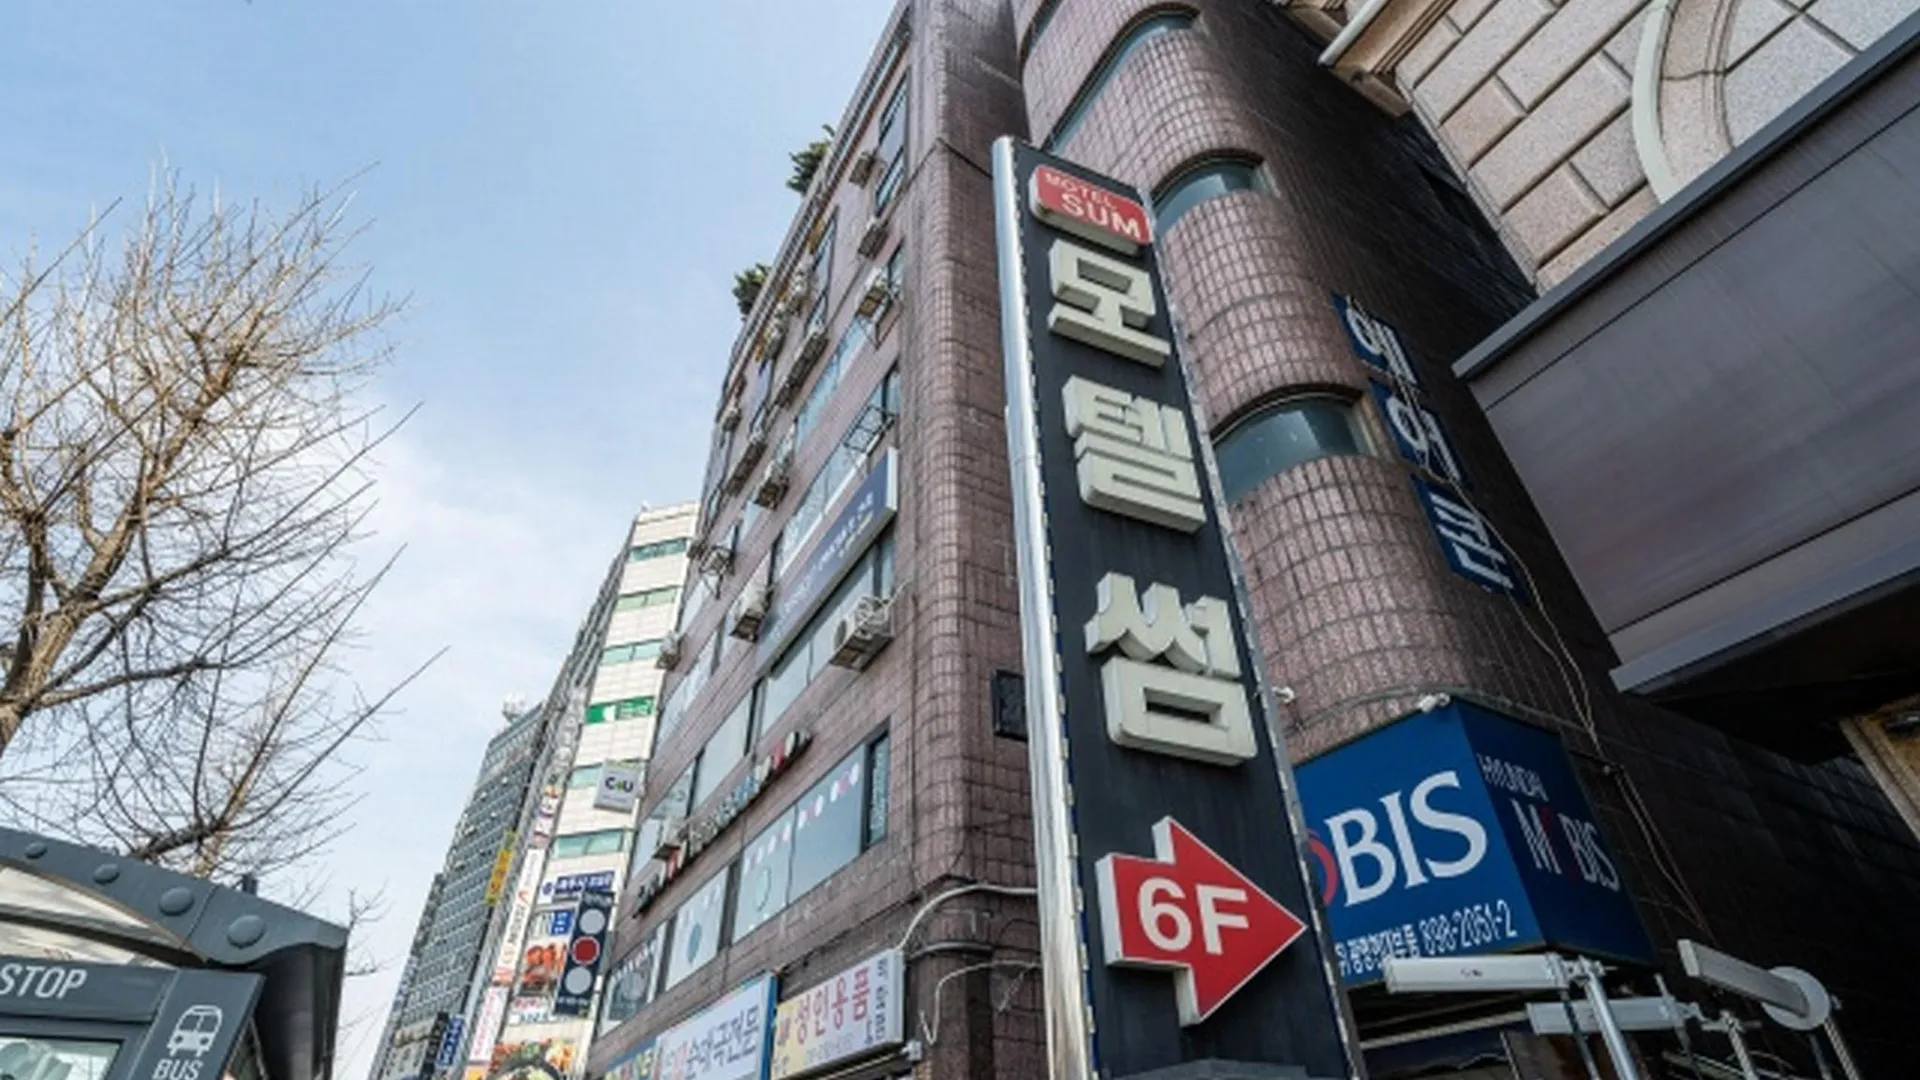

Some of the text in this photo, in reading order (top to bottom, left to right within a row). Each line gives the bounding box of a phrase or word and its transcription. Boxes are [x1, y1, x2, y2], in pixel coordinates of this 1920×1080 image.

[1044, 172, 1118, 211] MOTEL
[1060, 193, 1141, 239] SUM
[1137, 876, 1250, 956] 6F
[0, 963, 88, 1000] STOP
[795, 966, 871, 1046] 성인용품
[152, 1058, 204, 1080] BUS
